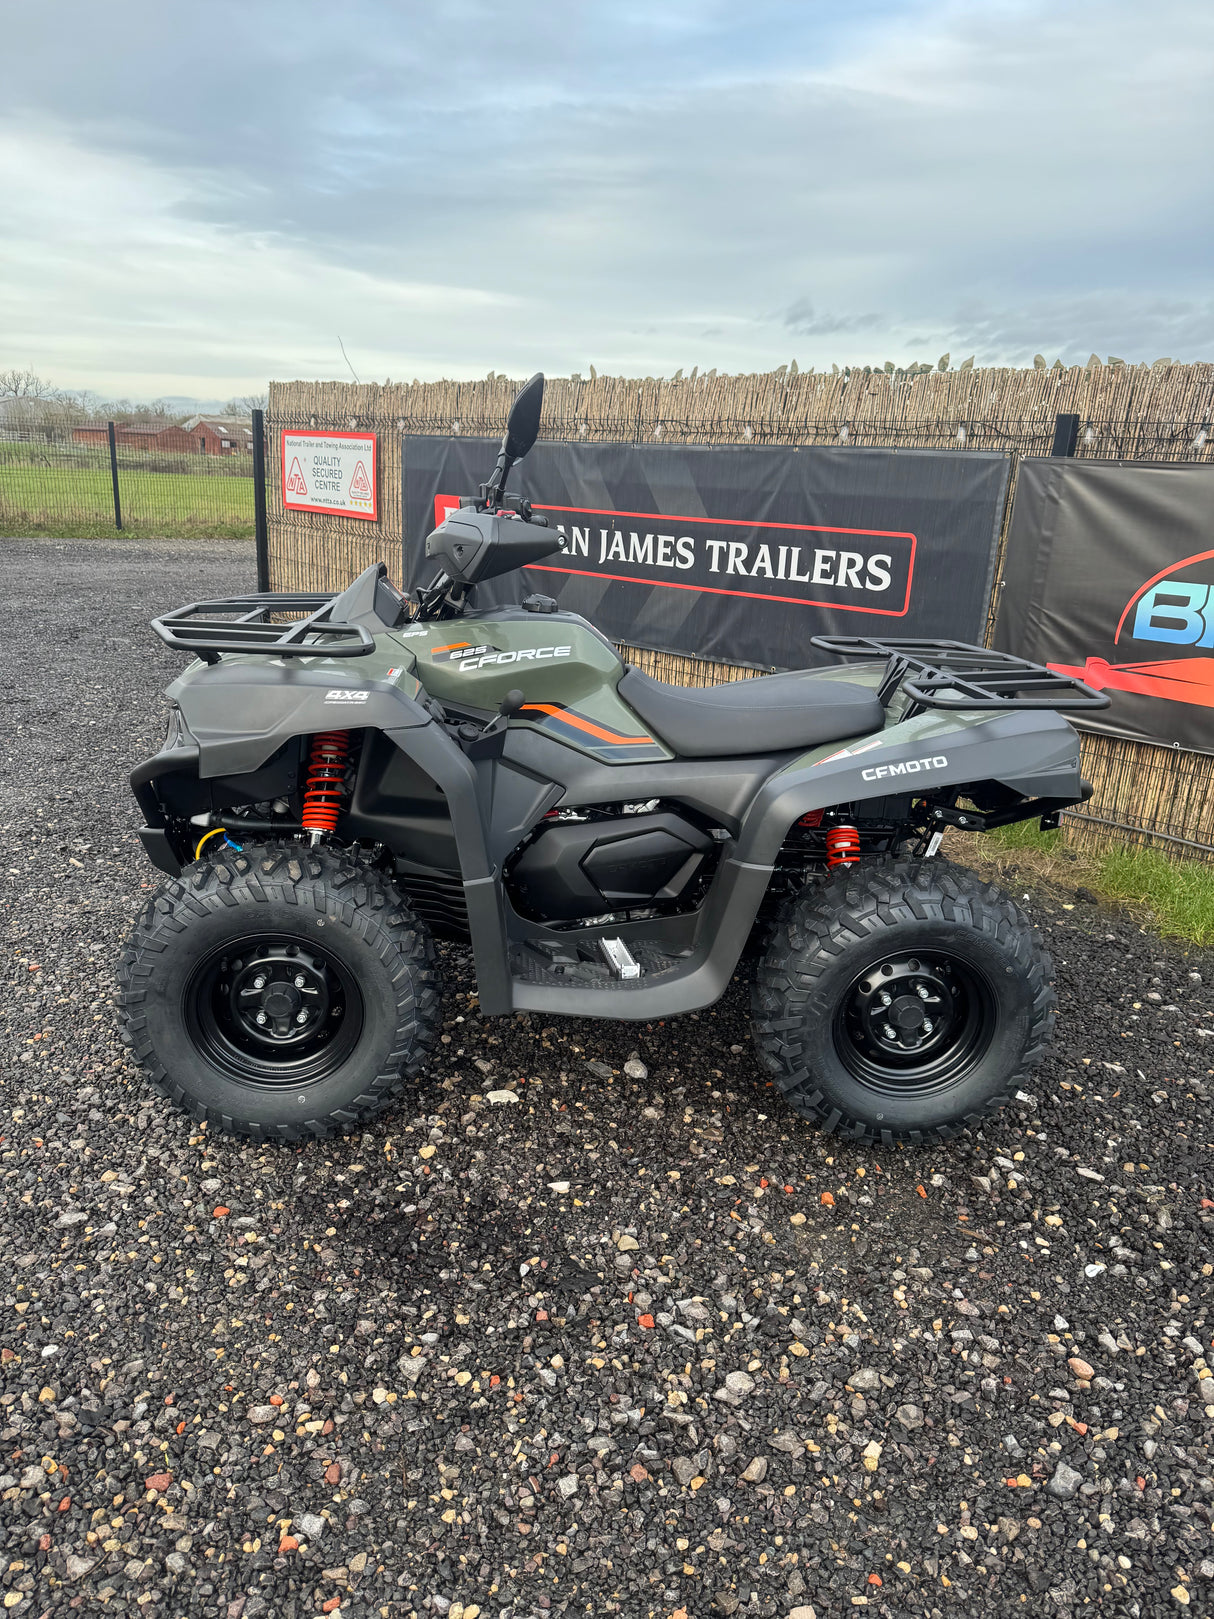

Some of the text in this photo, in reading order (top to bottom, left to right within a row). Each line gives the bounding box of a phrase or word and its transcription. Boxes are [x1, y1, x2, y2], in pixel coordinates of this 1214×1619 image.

[303, 440, 314, 448] Trailer
[323, 441, 339, 451] Towing
[339, 443, 363, 452] Association
[363, 444, 372, 452] Ltd
[313, 455, 342, 467] QUALITY
[312, 468, 343, 480] SECURED
[314, 480, 341, 492] CENTRE
[598, 529, 696, 571] JAMES
[705, 539, 893, 592] TRAILERS
[1132, 580, 1214, 649] B
[402, 630, 429, 638] EPS
[449, 645, 488, 660] 625
[458, 645, 572, 672] CFORCE
[861, 755, 949, 782] CFMOTO
